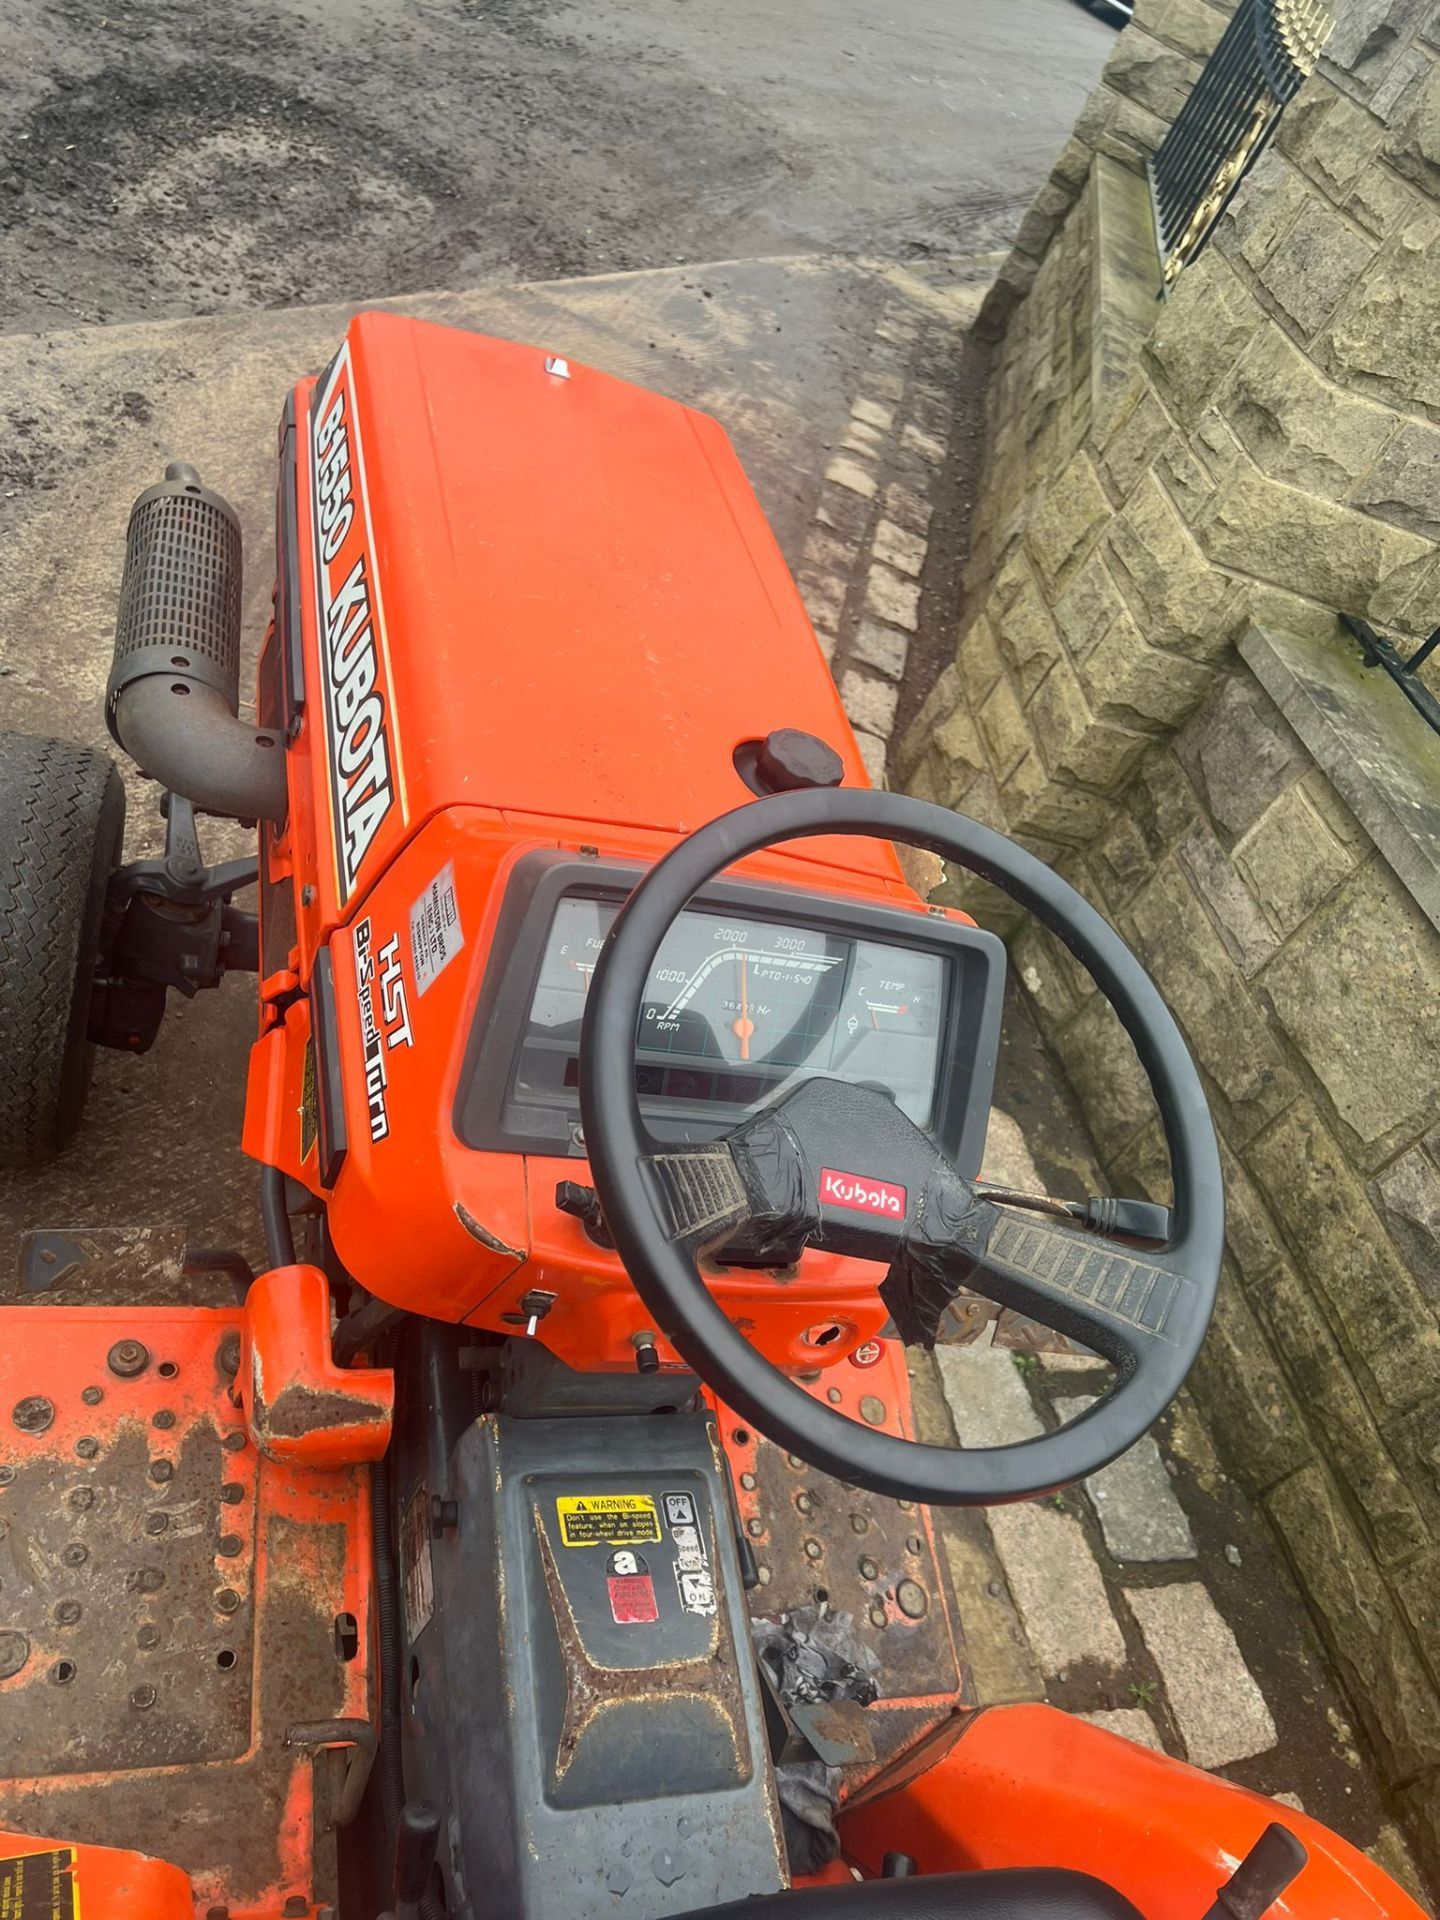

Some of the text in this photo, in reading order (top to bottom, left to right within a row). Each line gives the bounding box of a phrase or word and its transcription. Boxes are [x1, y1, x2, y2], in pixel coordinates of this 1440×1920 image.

[318, 388, 395, 886] B1550 KUBOTA
[432, 882, 442, 932] HAMILTON
[713, 928, 748, 943] 2000
[559, 944, 569, 955] E
[774, 936, 807, 951] 3000
[655, 969, 685, 984] 1000
[378, 931, 415, 1051] HST
[880, 980, 905, 990] TEMP
[646, 1009, 655, 1020] 0
[656, 1021, 680, 1032] RPM
[825, 1175, 900, 1213] Kubota
[591, 1500, 636, 1510] WARNING
[669, 1498, 687, 1506] OFF
[614, 1551, 638, 1575] a
[689, 1593, 706, 1602] ON
